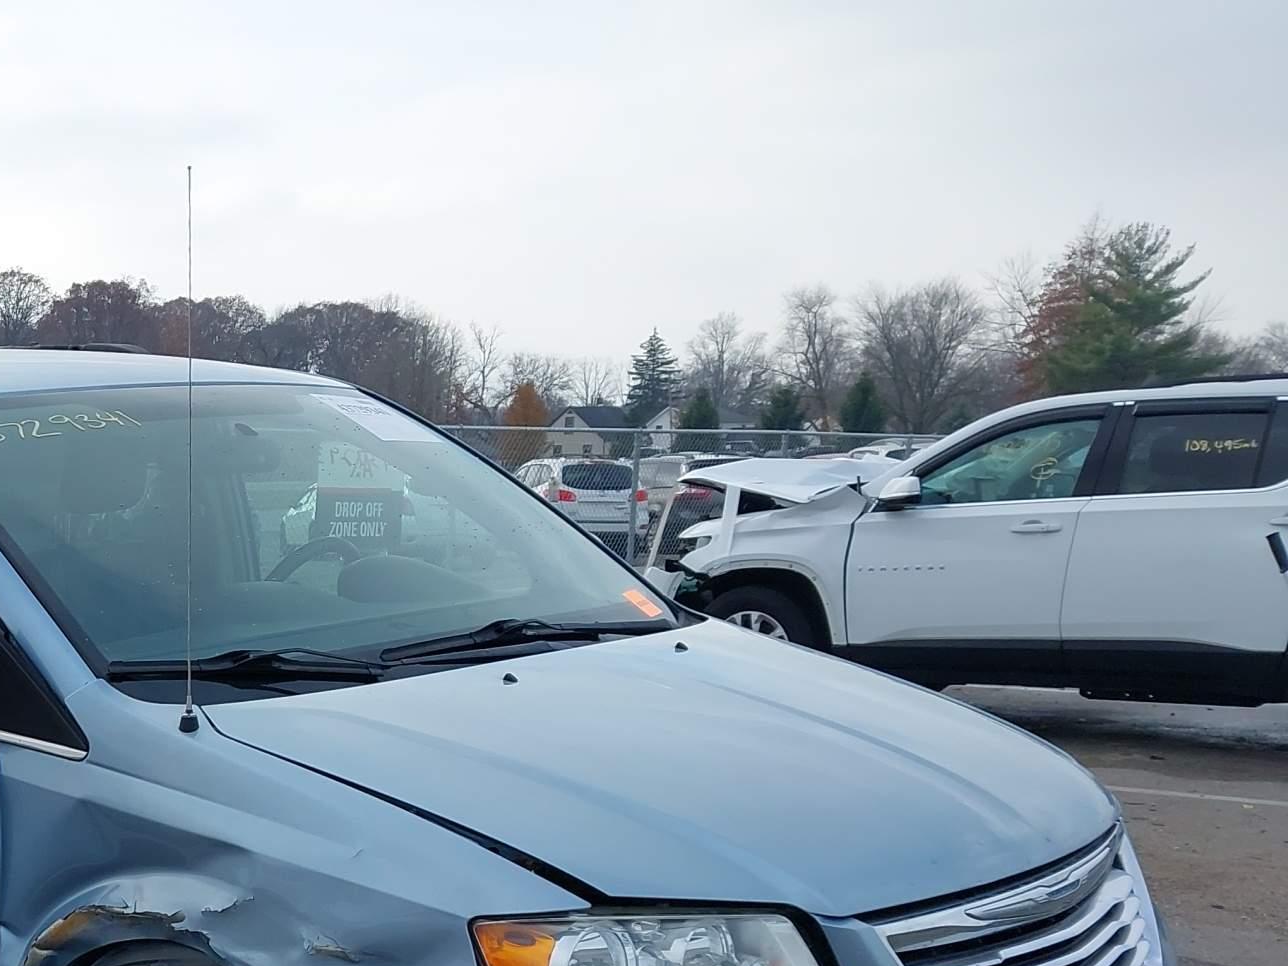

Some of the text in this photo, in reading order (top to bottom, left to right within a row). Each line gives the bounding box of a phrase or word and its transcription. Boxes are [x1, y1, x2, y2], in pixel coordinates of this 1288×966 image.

[335, 501, 384, 518] DROP OFF
[328, 521, 387, 537] ZONE ONLY
